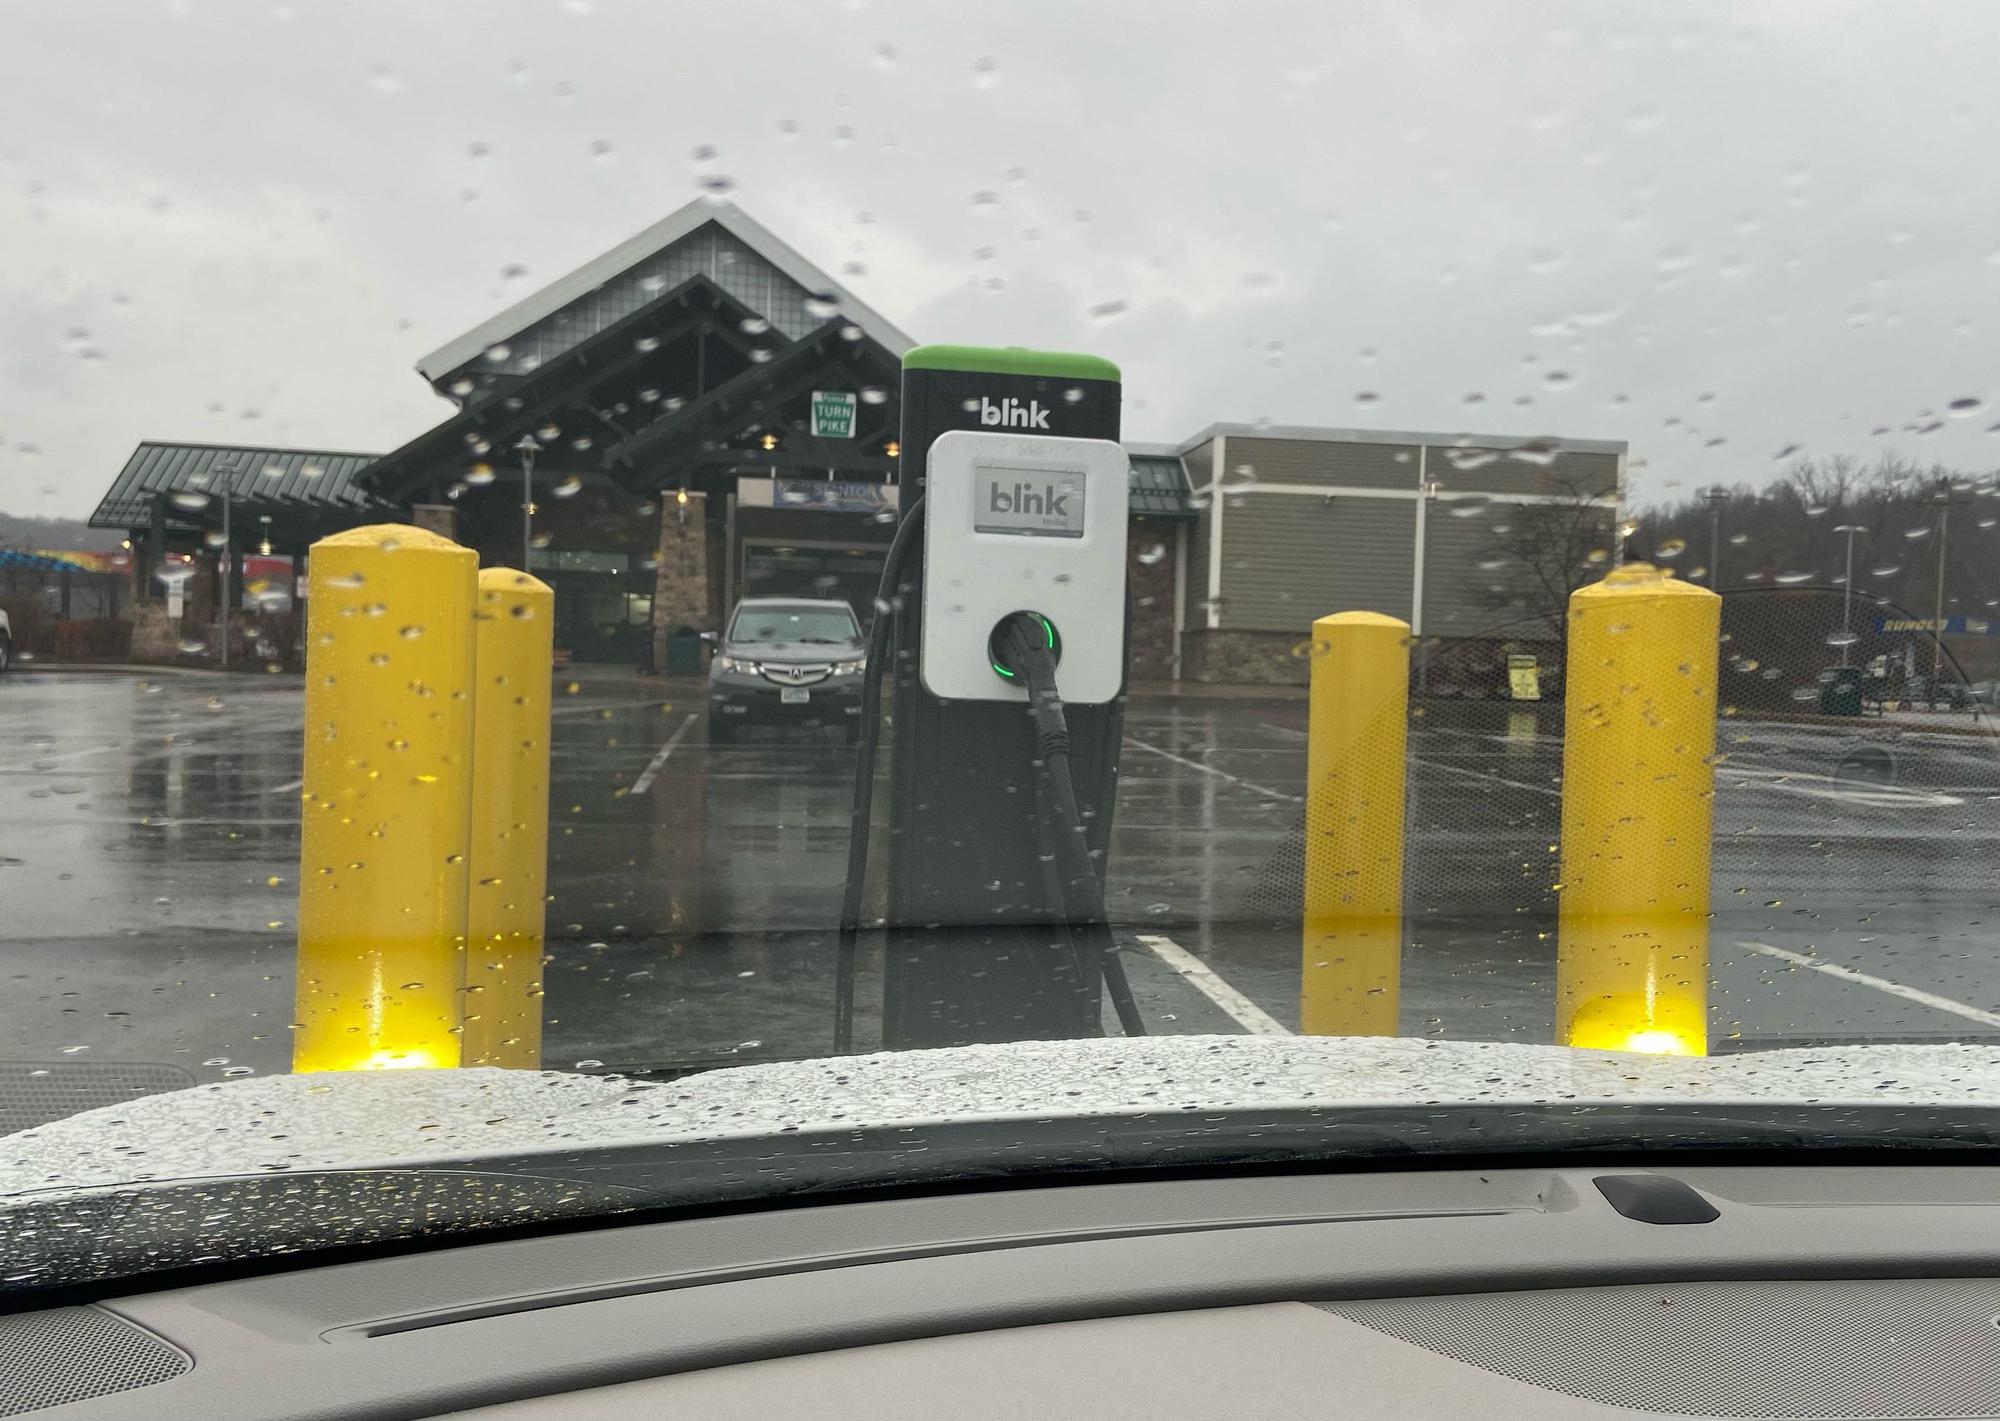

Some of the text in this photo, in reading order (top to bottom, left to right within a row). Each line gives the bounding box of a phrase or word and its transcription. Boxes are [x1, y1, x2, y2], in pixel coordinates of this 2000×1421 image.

[818, 405, 851, 417] TURN
[981, 397, 1050, 429] blink
[819, 420, 848, 433] PIKE
[990, 482, 1068, 516] blink
